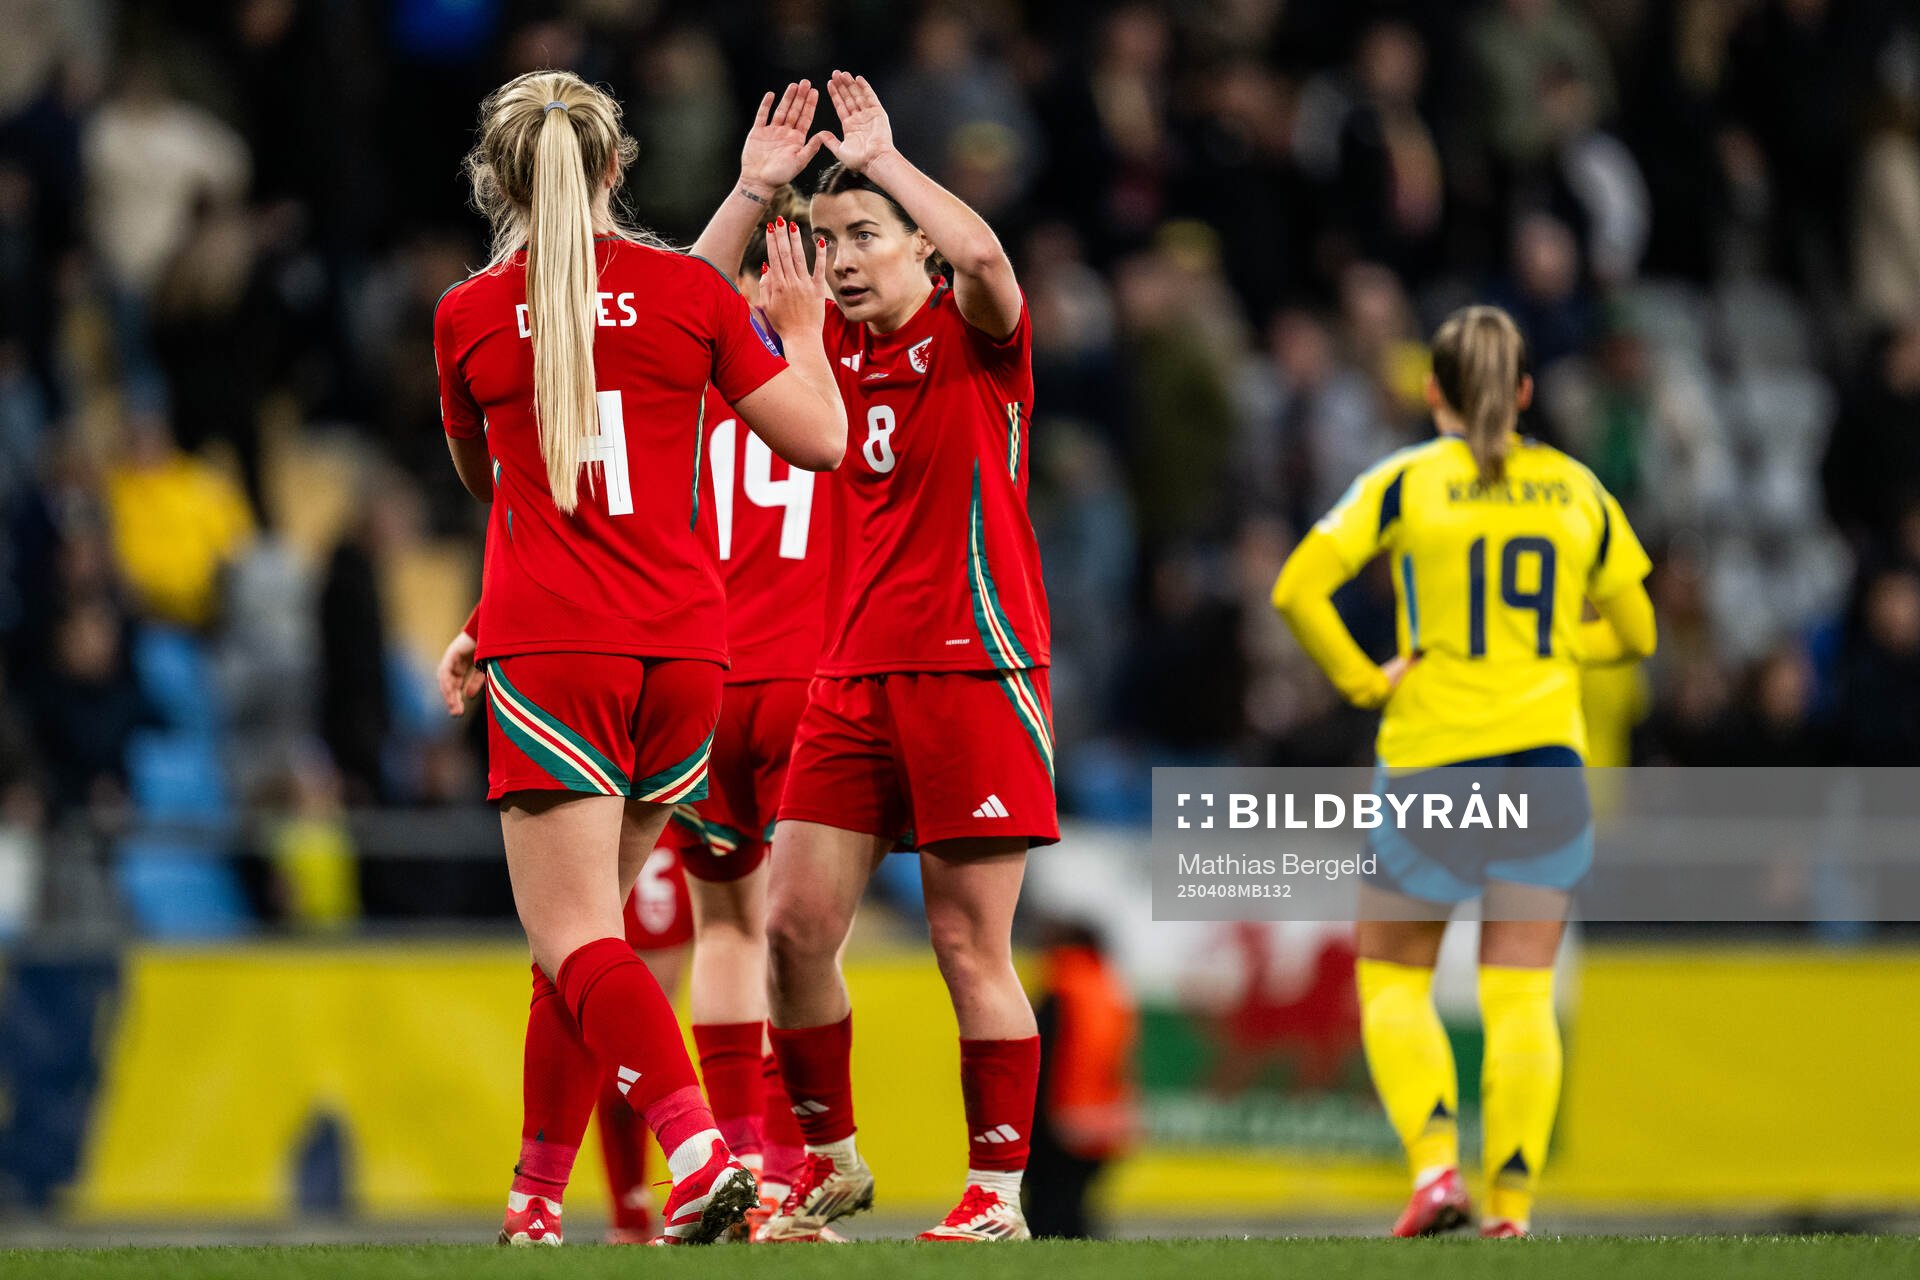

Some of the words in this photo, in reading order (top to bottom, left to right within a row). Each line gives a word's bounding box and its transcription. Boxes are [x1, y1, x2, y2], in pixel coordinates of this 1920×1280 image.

[515, 291, 638, 339] DES
[578, 388, 634, 516] 4
[863, 405, 896, 473] 8
[1469, 535, 1556, 657] 19
